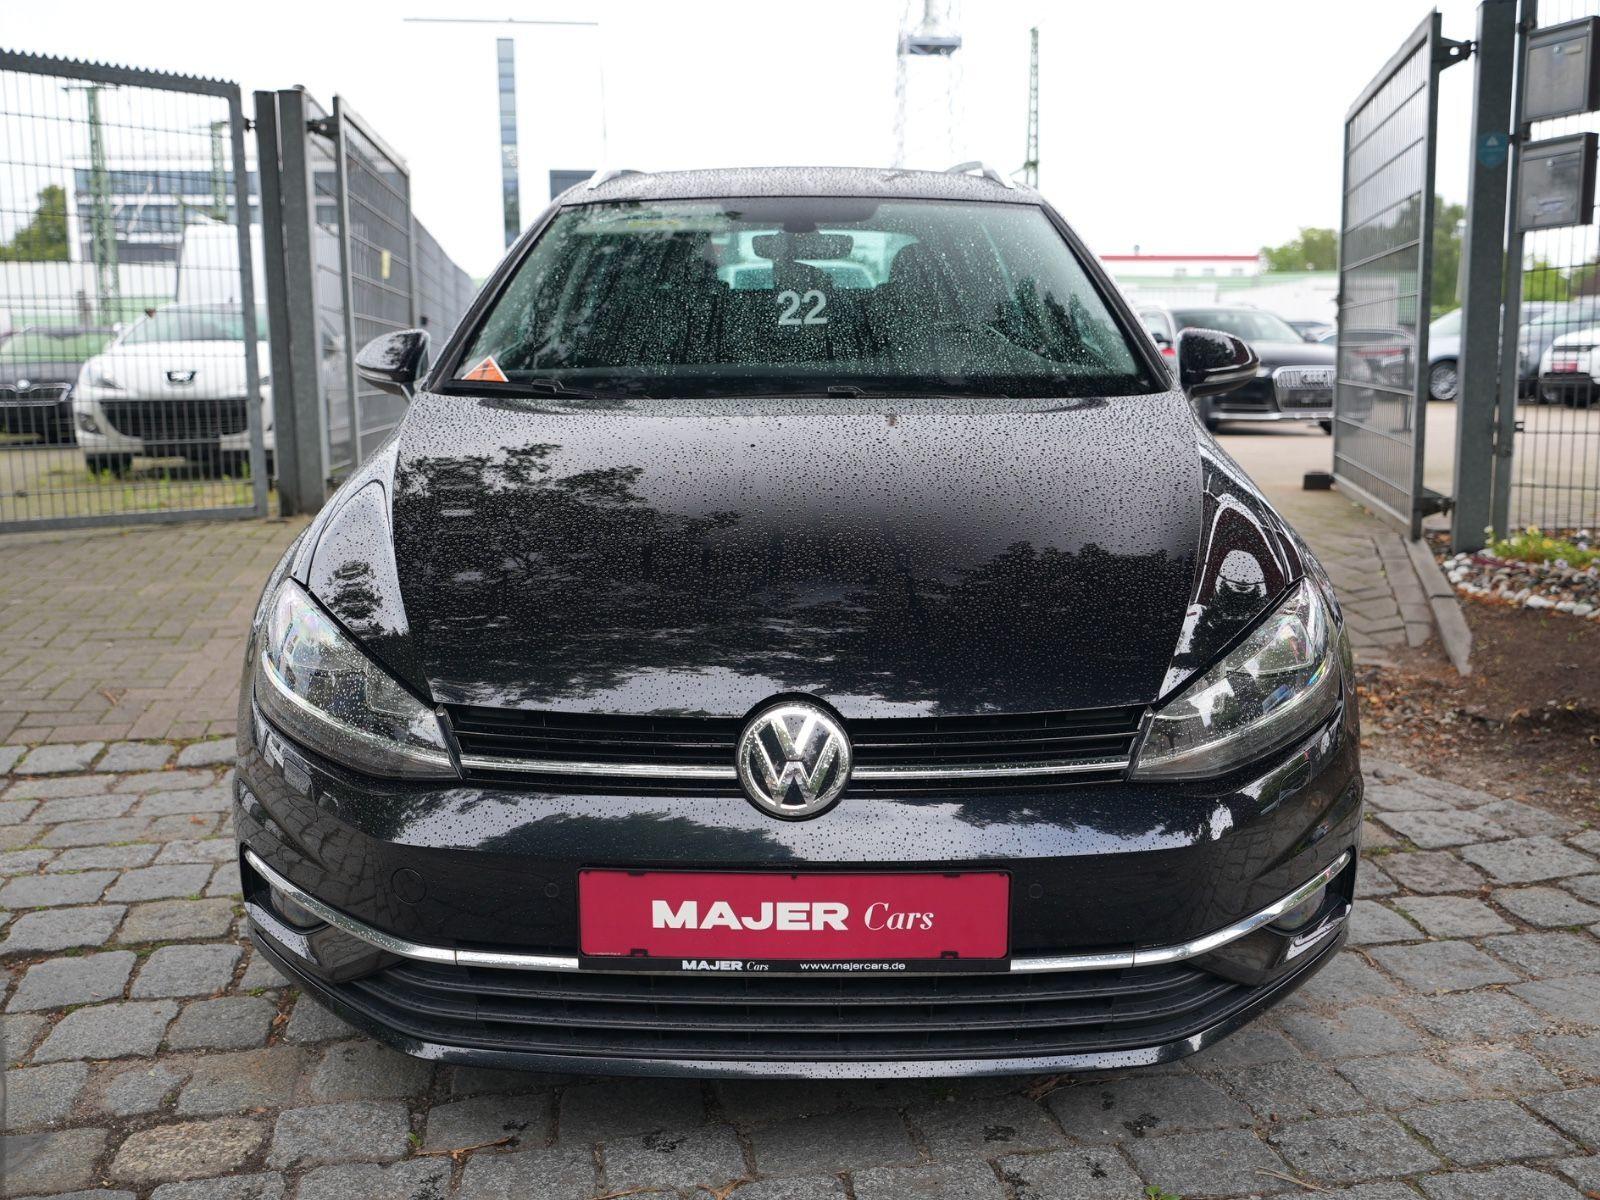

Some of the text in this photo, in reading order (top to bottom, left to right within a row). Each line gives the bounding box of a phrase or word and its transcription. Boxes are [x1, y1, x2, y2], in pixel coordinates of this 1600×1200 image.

[777, 289, 828, 326] 22
[739, 701, 850, 817] VW
[651, 900, 935, 931] MAJER Cars
[681, 960, 770, 972] MAJER Cars
[799, 962, 907, 972] www.majercars.de
